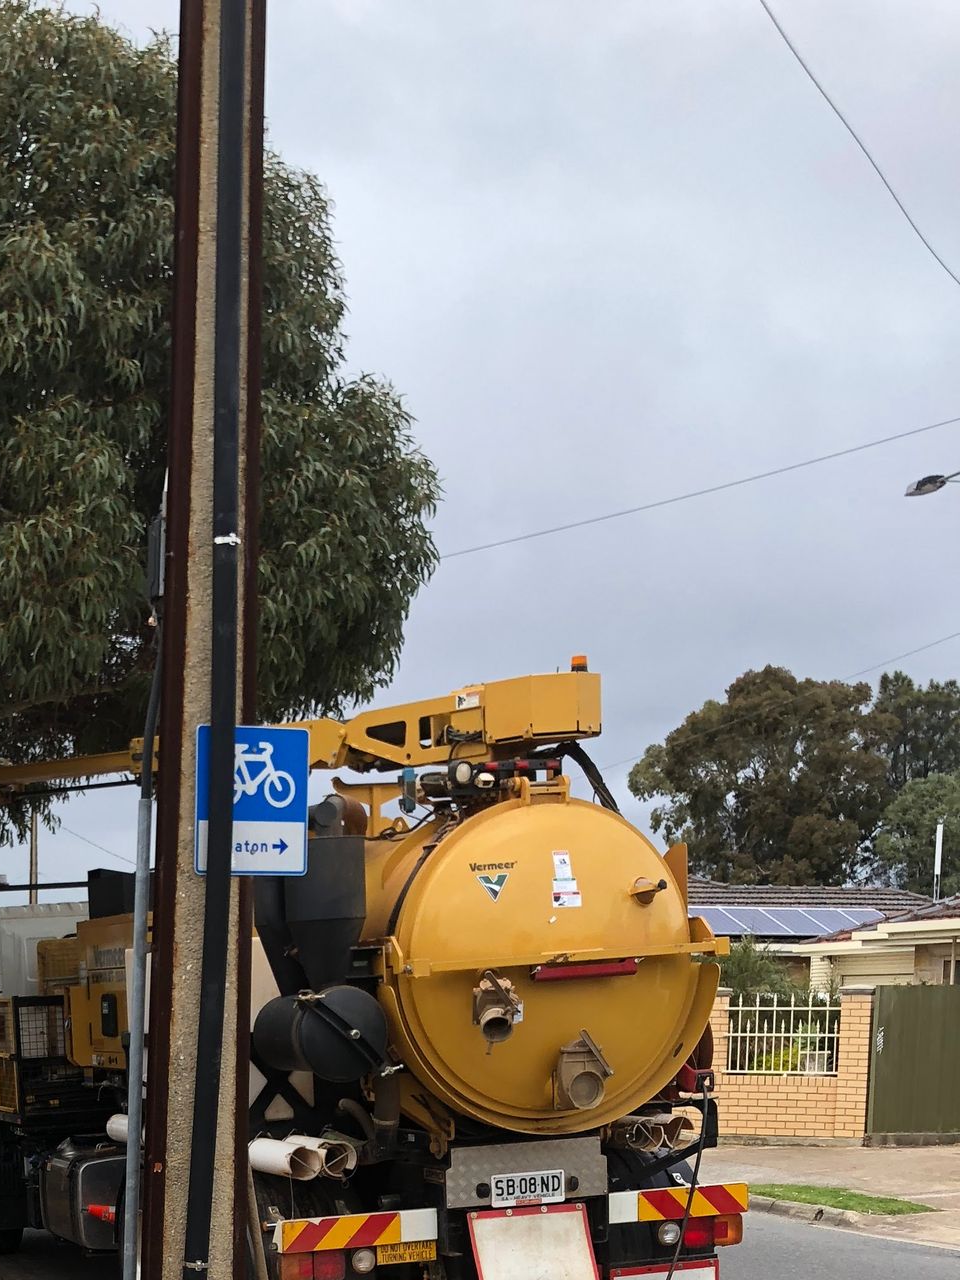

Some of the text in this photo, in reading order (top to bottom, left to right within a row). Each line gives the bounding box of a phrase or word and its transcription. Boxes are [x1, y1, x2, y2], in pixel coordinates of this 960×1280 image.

[235, 842, 268, 855] aton
[469, 860, 515, 872] Vermeer
[382, 1249, 433, 1263] TURNING VEHICLE
